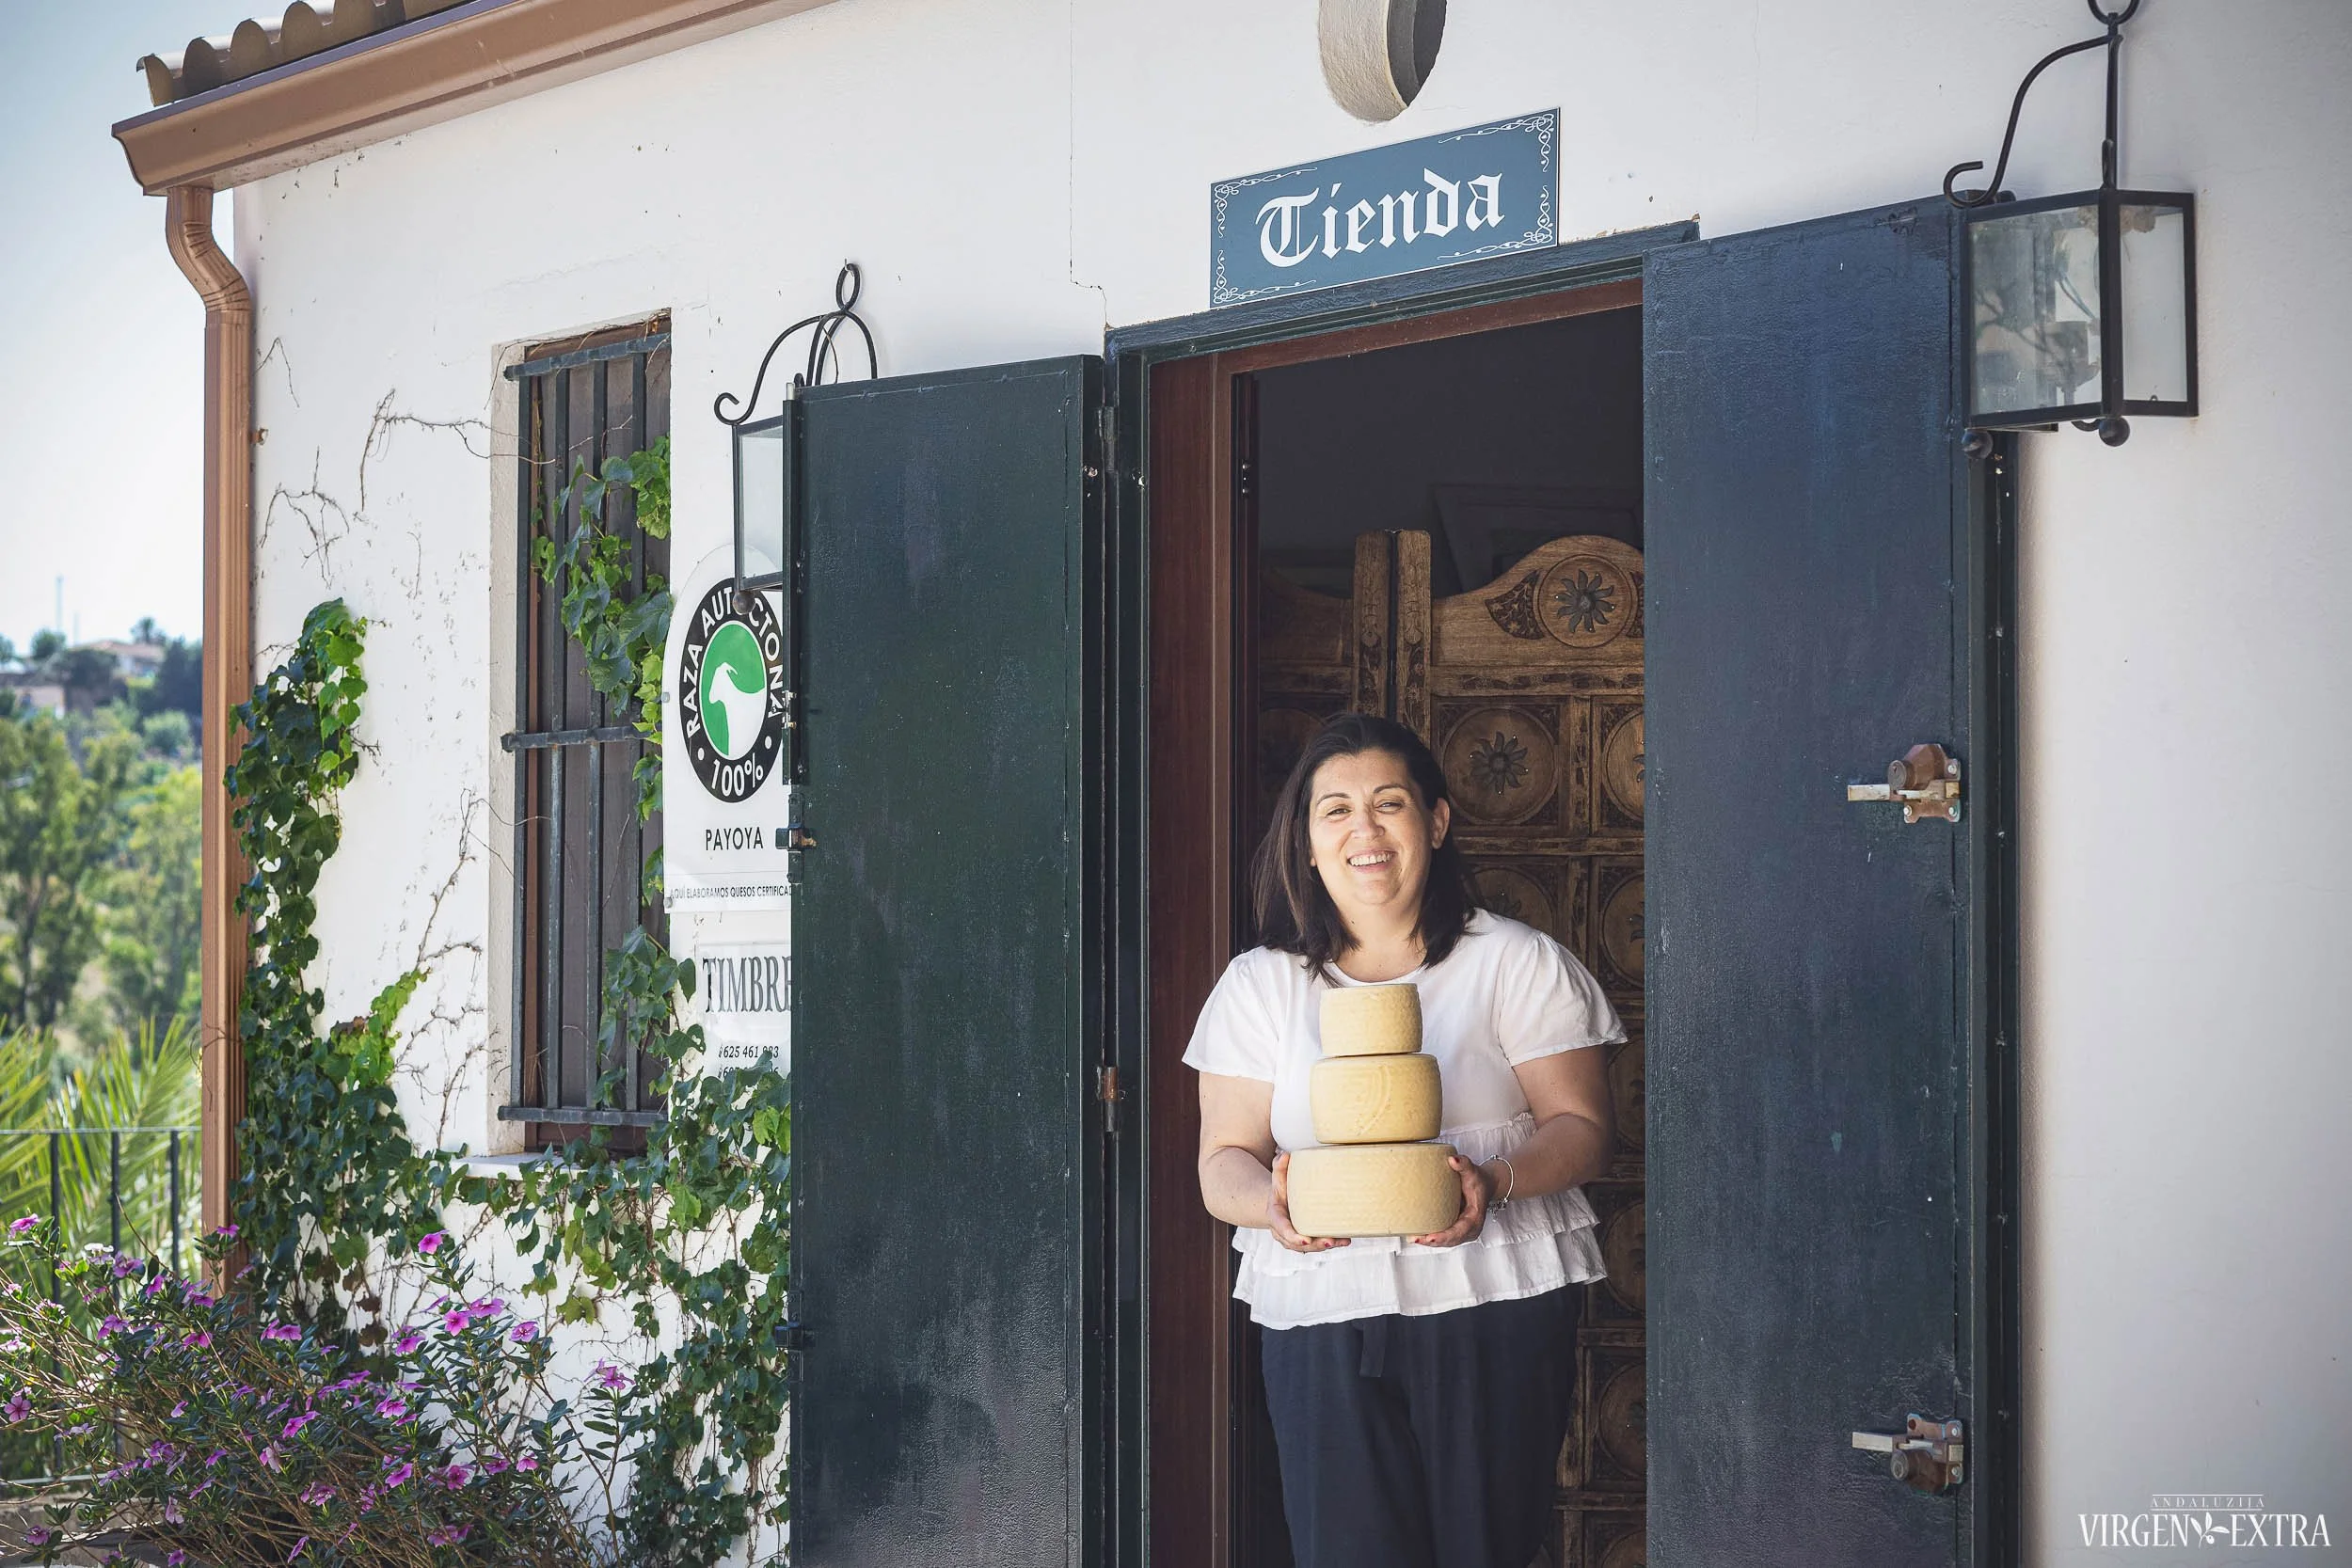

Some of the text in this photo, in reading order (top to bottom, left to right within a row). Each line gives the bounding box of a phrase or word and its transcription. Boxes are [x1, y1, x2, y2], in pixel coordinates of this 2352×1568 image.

[1254, 167, 1505, 268] Tienda
[683, 586, 784, 738] RAZA AUTCTONA
[711, 752, 764, 797] 100%
[705, 826, 764, 851] PAYOYA
[687, 886, 729, 899] ELABORAMOS
[730, 886, 755, 897] QUESOS
[723, 1045, 740, 1058] 625
[742, 1045, 759, 1058] 461
